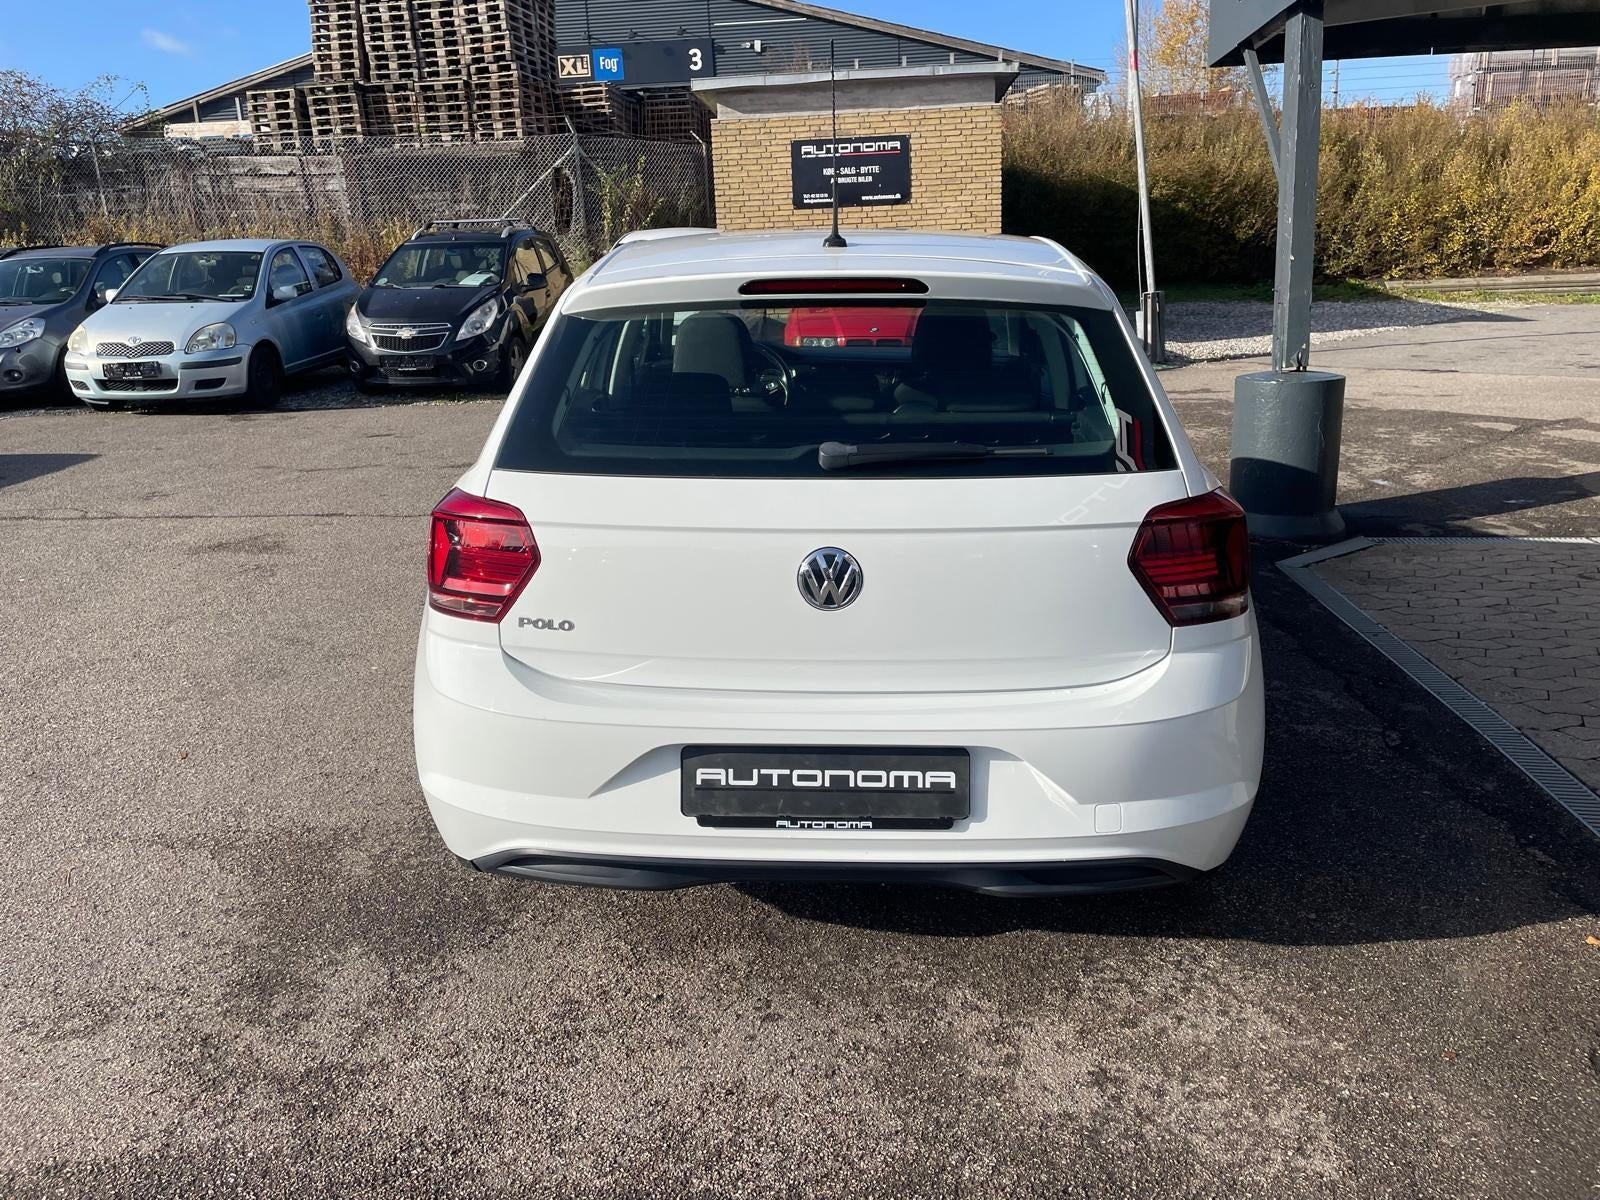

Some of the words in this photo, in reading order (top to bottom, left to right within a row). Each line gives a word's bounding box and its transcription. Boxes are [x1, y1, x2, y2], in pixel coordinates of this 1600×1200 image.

[560, 57, 588, 76] XL
[599, 56, 618, 73] Fog
[688, 48, 703, 71] 3
[801, 141, 901, 155] AUTONOMA
[839, 166, 856, 175] SALG
[860, 165, 880, 174] BYTTE
[837, 176, 858, 184] BRUGTE
[858, 175, 873, 183] BILER
[518, 616, 576, 632] POLO
[695, 768, 956, 789] AUTONOMA
[775, 820, 873, 829] AUTONOMA
